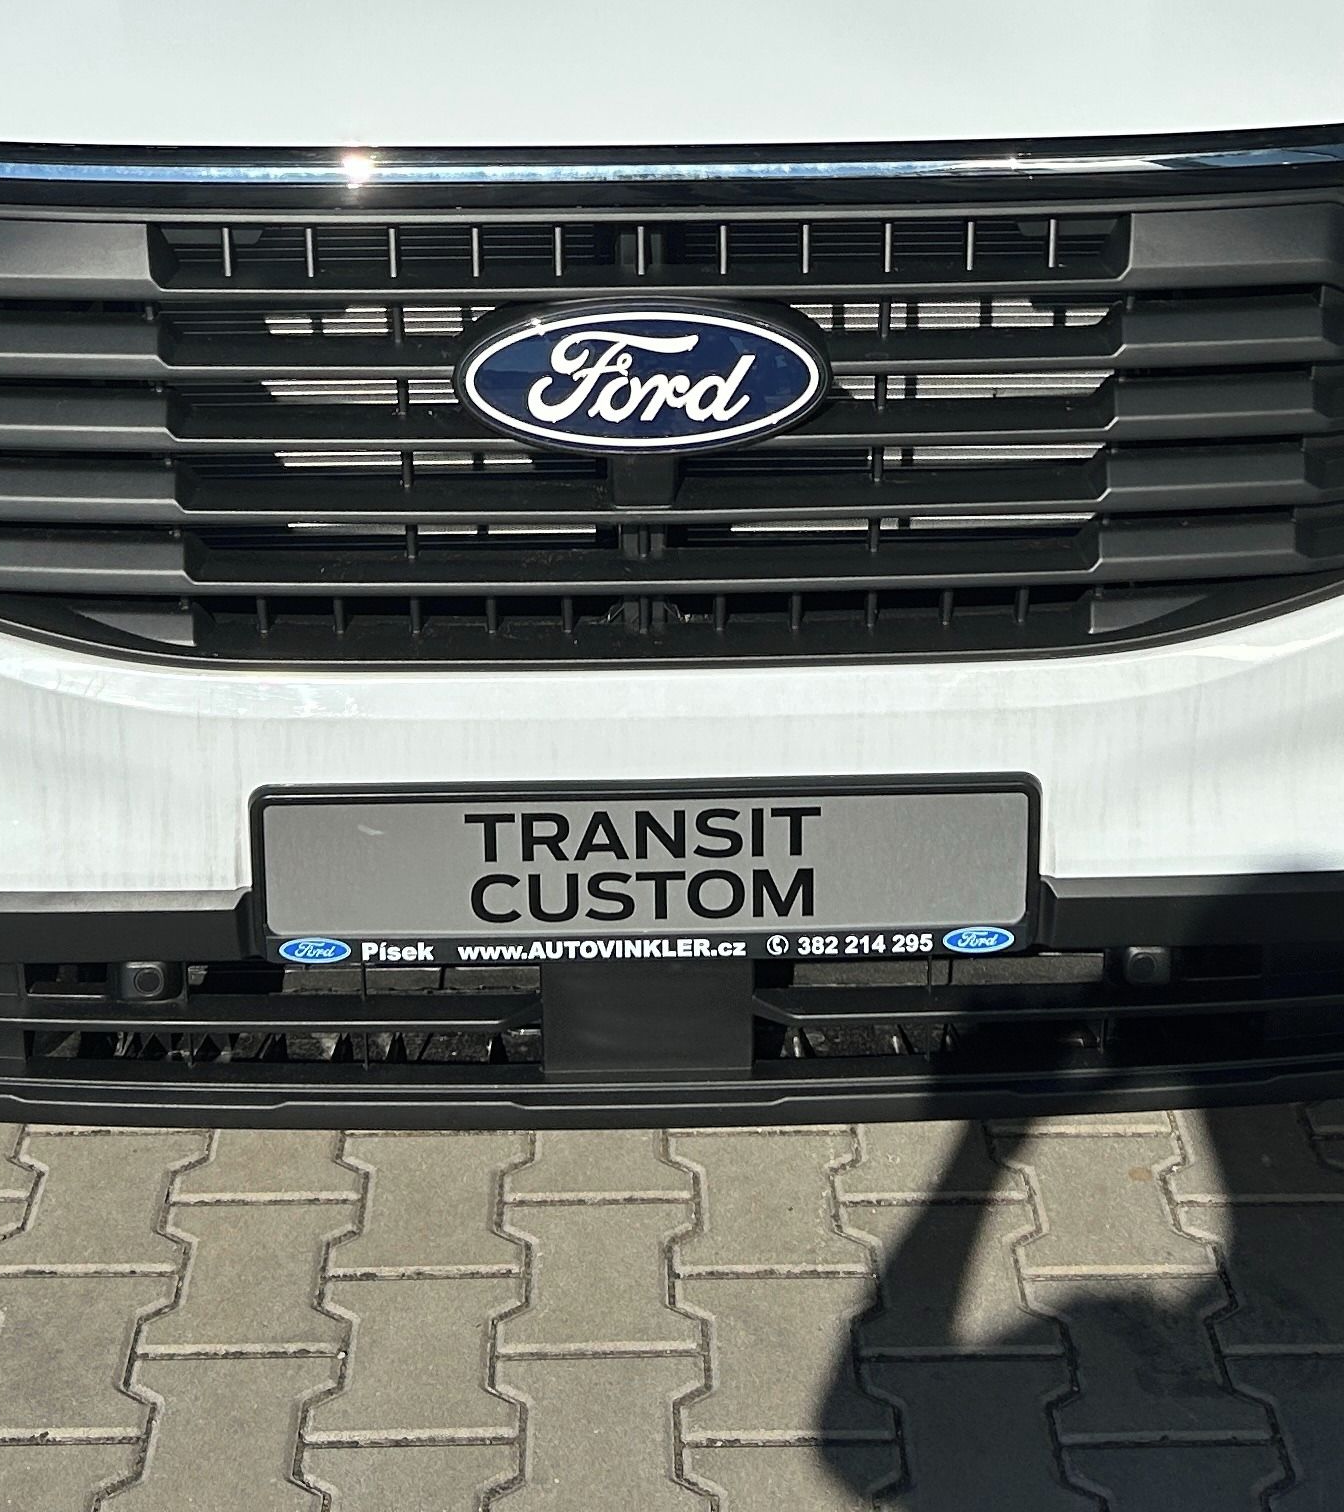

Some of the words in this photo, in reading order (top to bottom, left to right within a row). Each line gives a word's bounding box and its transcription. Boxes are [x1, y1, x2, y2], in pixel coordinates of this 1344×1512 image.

[527, 330, 756, 423] Ford
[464, 806, 821, 863] TRANSIT
[470, 867, 814, 924] CUSTOM
[293, 942, 336, 959] Ford
[361, 941, 435, 961] Písek
[457, 938, 747, 960] www.AUTOVINKLER.cz
[797, 936, 838, 955] 382
[844, 935, 886, 954] 214
[891, 933, 934, 953] 295
[957, 930, 997, 947] Ford
